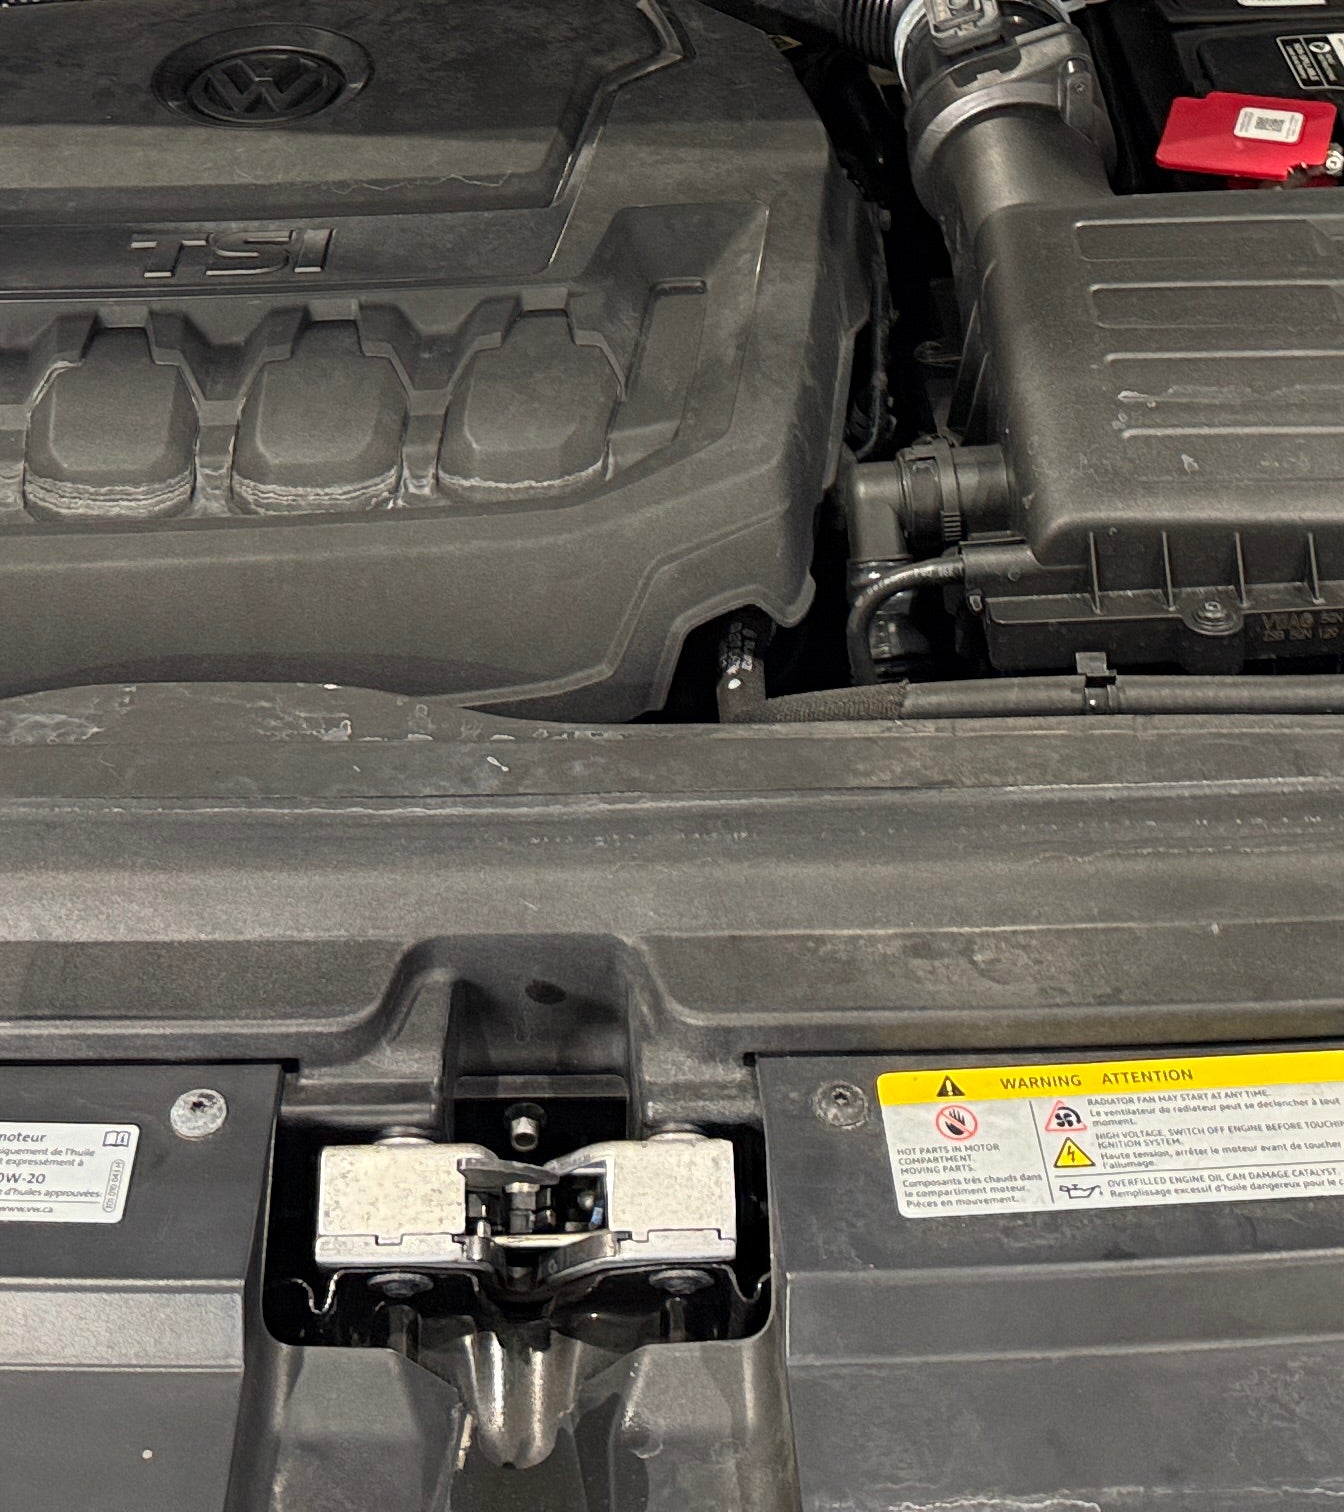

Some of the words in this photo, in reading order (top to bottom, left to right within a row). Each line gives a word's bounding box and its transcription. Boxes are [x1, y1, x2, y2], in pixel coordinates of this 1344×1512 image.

[130, 228, 337, 279] TSI
[1000, 1074, 1082, 1090] WARNING
[1102, 1068, 1193, 1085] ATTENTION
[1087, 1095, 1135, 1106] RADIATOR
[1136, 1095, 1156, 1104] FAN
[1158, 1094, 1178, 1103] MAY
[1179, 1092, 1208, 1102] START
[1224, 1090, 1245, 1099] ANY
[1090, 1108, 1102, 1117] Le
[1103, 1106, 1156, 1117] ventilateur
[1158, 1105, 1171, 1114] de
[1173, 1103, 1217, 1113] radiateur
[1219, 1101, 1243, 1112] peut
[1096, 1131, 1120, 1140] HIGH
[1168, 1127, 1205, 1137] SWITCH
[1207, 1125, 1225, 1134] OFF
[1228, 1123, 1263, 1133] ENGINE
[1265, 1121, 1304, 1131] BEFORE
[51, 1147, 63, 1156] de
[897, 1147, 917, 1157] HOT
[919, 1145, 950, 1155] PARTS
[951, 1144, 962, 1153] IN
[964, 1143, 1000, 1153] MOTOR
[1098, 1139, 1142, 1149] IGNITION
[1101, 1152, 1131, 1161] Haute
[1221, 1144, 1258, 1153] moteur
[1260, 1142, 1288, 1152] avant
[1290, 1141, 1302, 1150] de
[1304, 1139, 1341, 1150] toucher
[901, 1165, 941, 1175] MOVING
[902, 1177, 962, 1188] Composants
[983, 1174, 1017, 1184] chauds
[1019, 1172, 1042, 1182] dans
[1107, 1177, 1167, 1188] OVERFILLED
[1169, 1174, 1206, 1184] ENGINE
[1207, 1173, 1224, 1182] OIL
[1226, 1172, 1247, 1181] CAN
[1248, 1169, 1290, 1180] DAMAGE
[915, 1186, 987, 1198] compartiment
[1110, 1188, 1172, 1199] Remplissage
[1174, 1185, 1213, 1195] excessif
[1250, 1181, 1301, 1191] dangereux
[1303, 1179, 1325, 1190] pour
[941, 1199, 953, 1207] en
